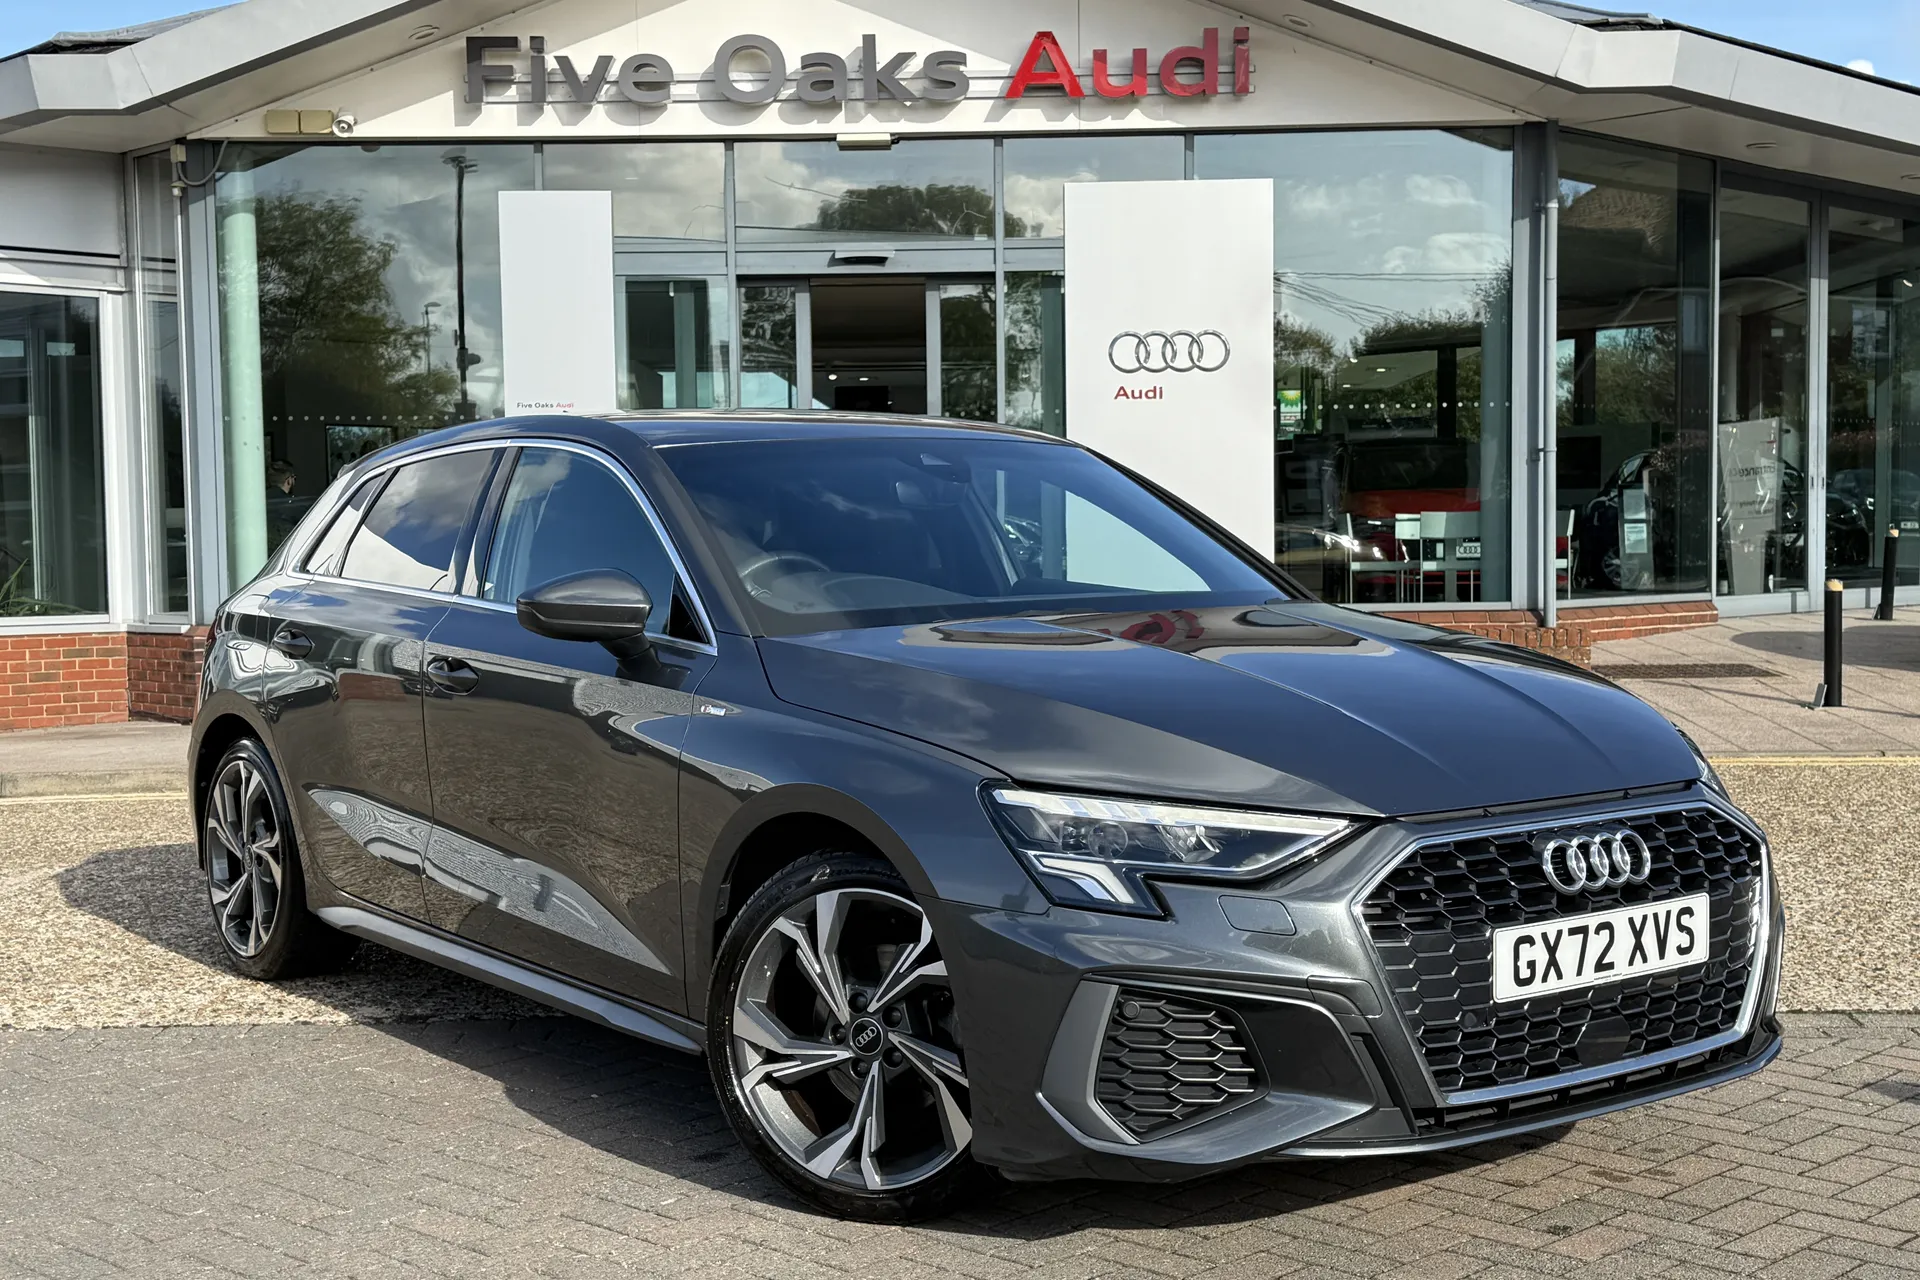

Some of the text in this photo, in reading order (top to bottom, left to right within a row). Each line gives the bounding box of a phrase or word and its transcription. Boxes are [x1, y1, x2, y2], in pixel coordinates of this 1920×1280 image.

[466, 26, 1250, 105] Five Oaks Audi
[1114, 385, 1163, 400] Audi
[1513, 905, 1696, 988] GX72 XVS
